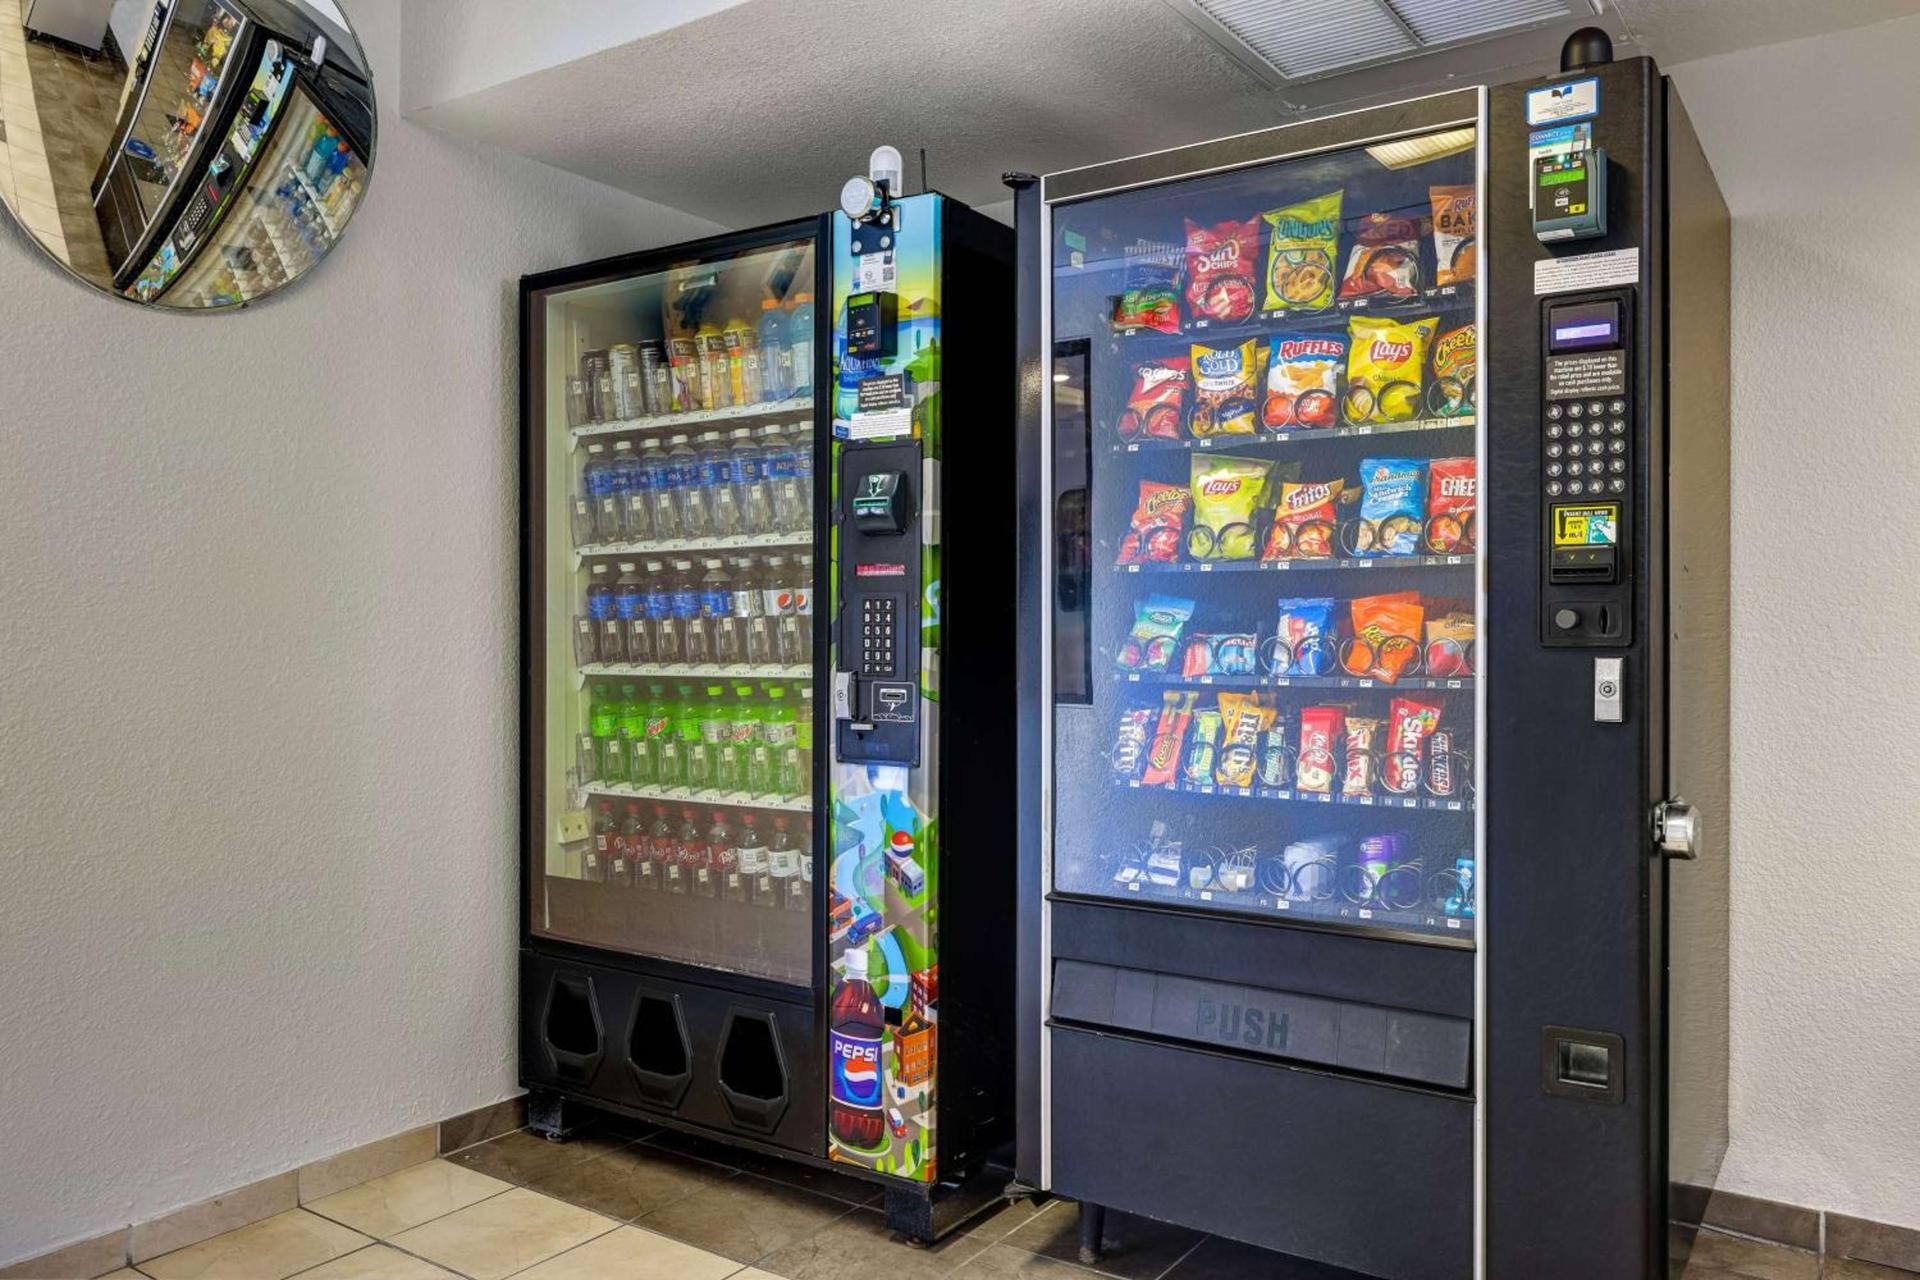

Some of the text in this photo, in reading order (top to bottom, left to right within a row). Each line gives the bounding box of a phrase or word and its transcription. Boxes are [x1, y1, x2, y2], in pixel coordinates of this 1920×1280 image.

[1209, 258, 1238, 270] CHIPS
[1280, 339, 1344, 360] RUFFLES
[1200, 358, 1239, 375] GOLD
[1288, 482, 1332, 510] Fritos
[864, 600, 892, 610] A 1 2
[864, 613, 892, 623] B 3 4
[864, 626, 871, 635] C
[875, 626, 881, 635] 5
[875, 638, 881, 648] 7
[864, 651, 871, 660] E
[875, 651, 881, 660] 9
[864, 664, 870, 673] F
[1196, 998, 1290, 1050] PUSH
[834, 1039, 879, 1062] PEPSI
